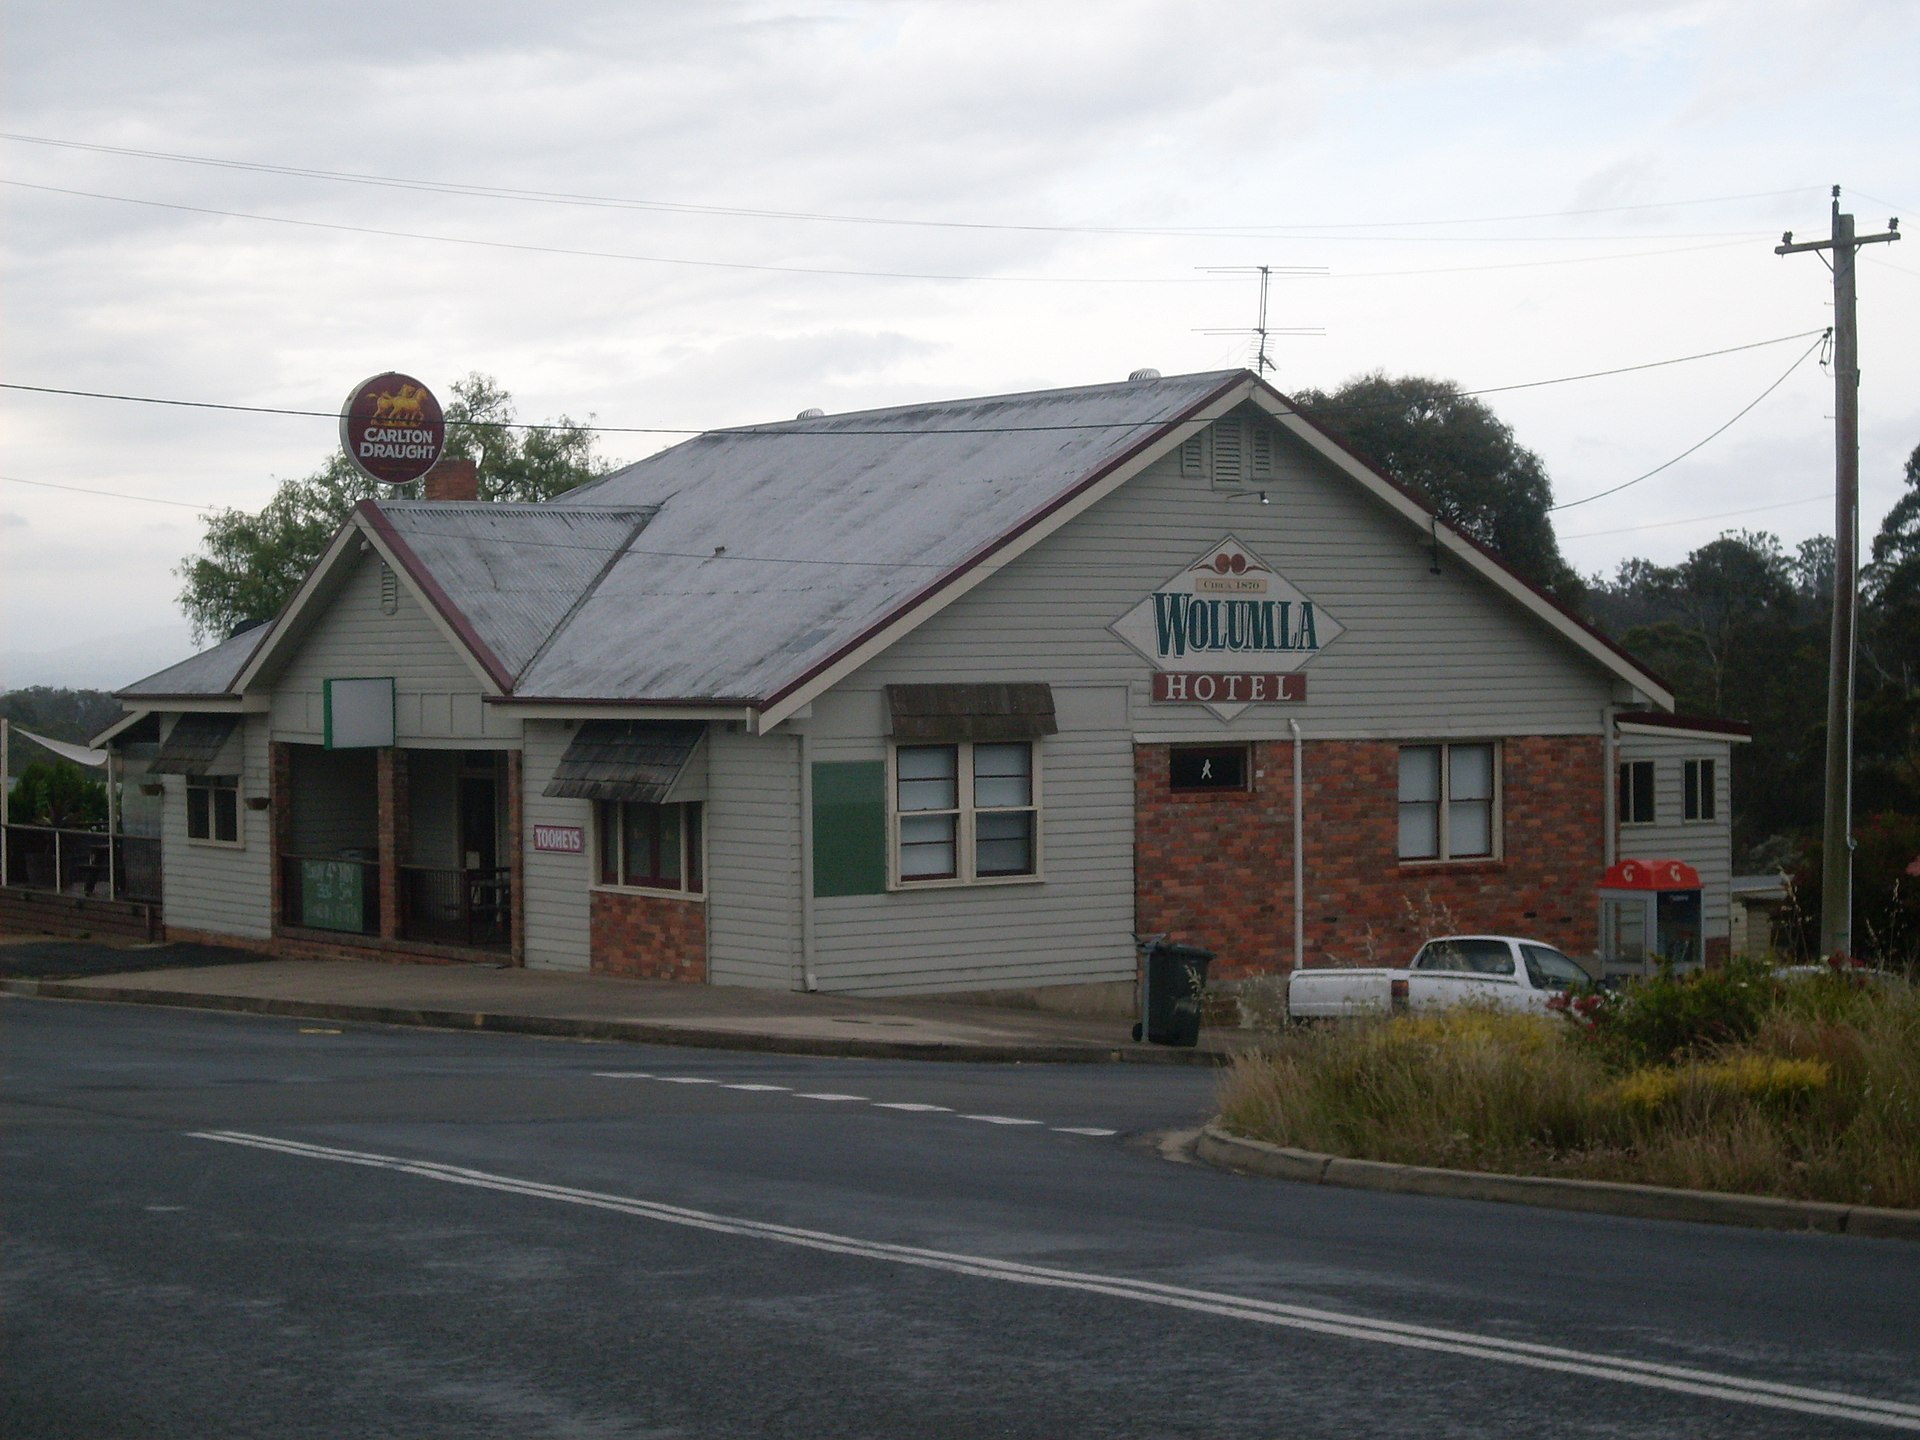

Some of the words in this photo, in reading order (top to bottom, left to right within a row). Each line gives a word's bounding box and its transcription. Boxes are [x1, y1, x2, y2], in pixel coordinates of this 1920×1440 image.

[363, 427, 433, 443] CARLTON
[360, 442, 435, 459] DRAUGHT
[1235, 581, 1261, 590] 1870
[1151, 592, 1320, 658] WOLUMLA
[1166, 674, 1292, 701] HOTEL
[535, 828, 581, 849] TOOHEYS
